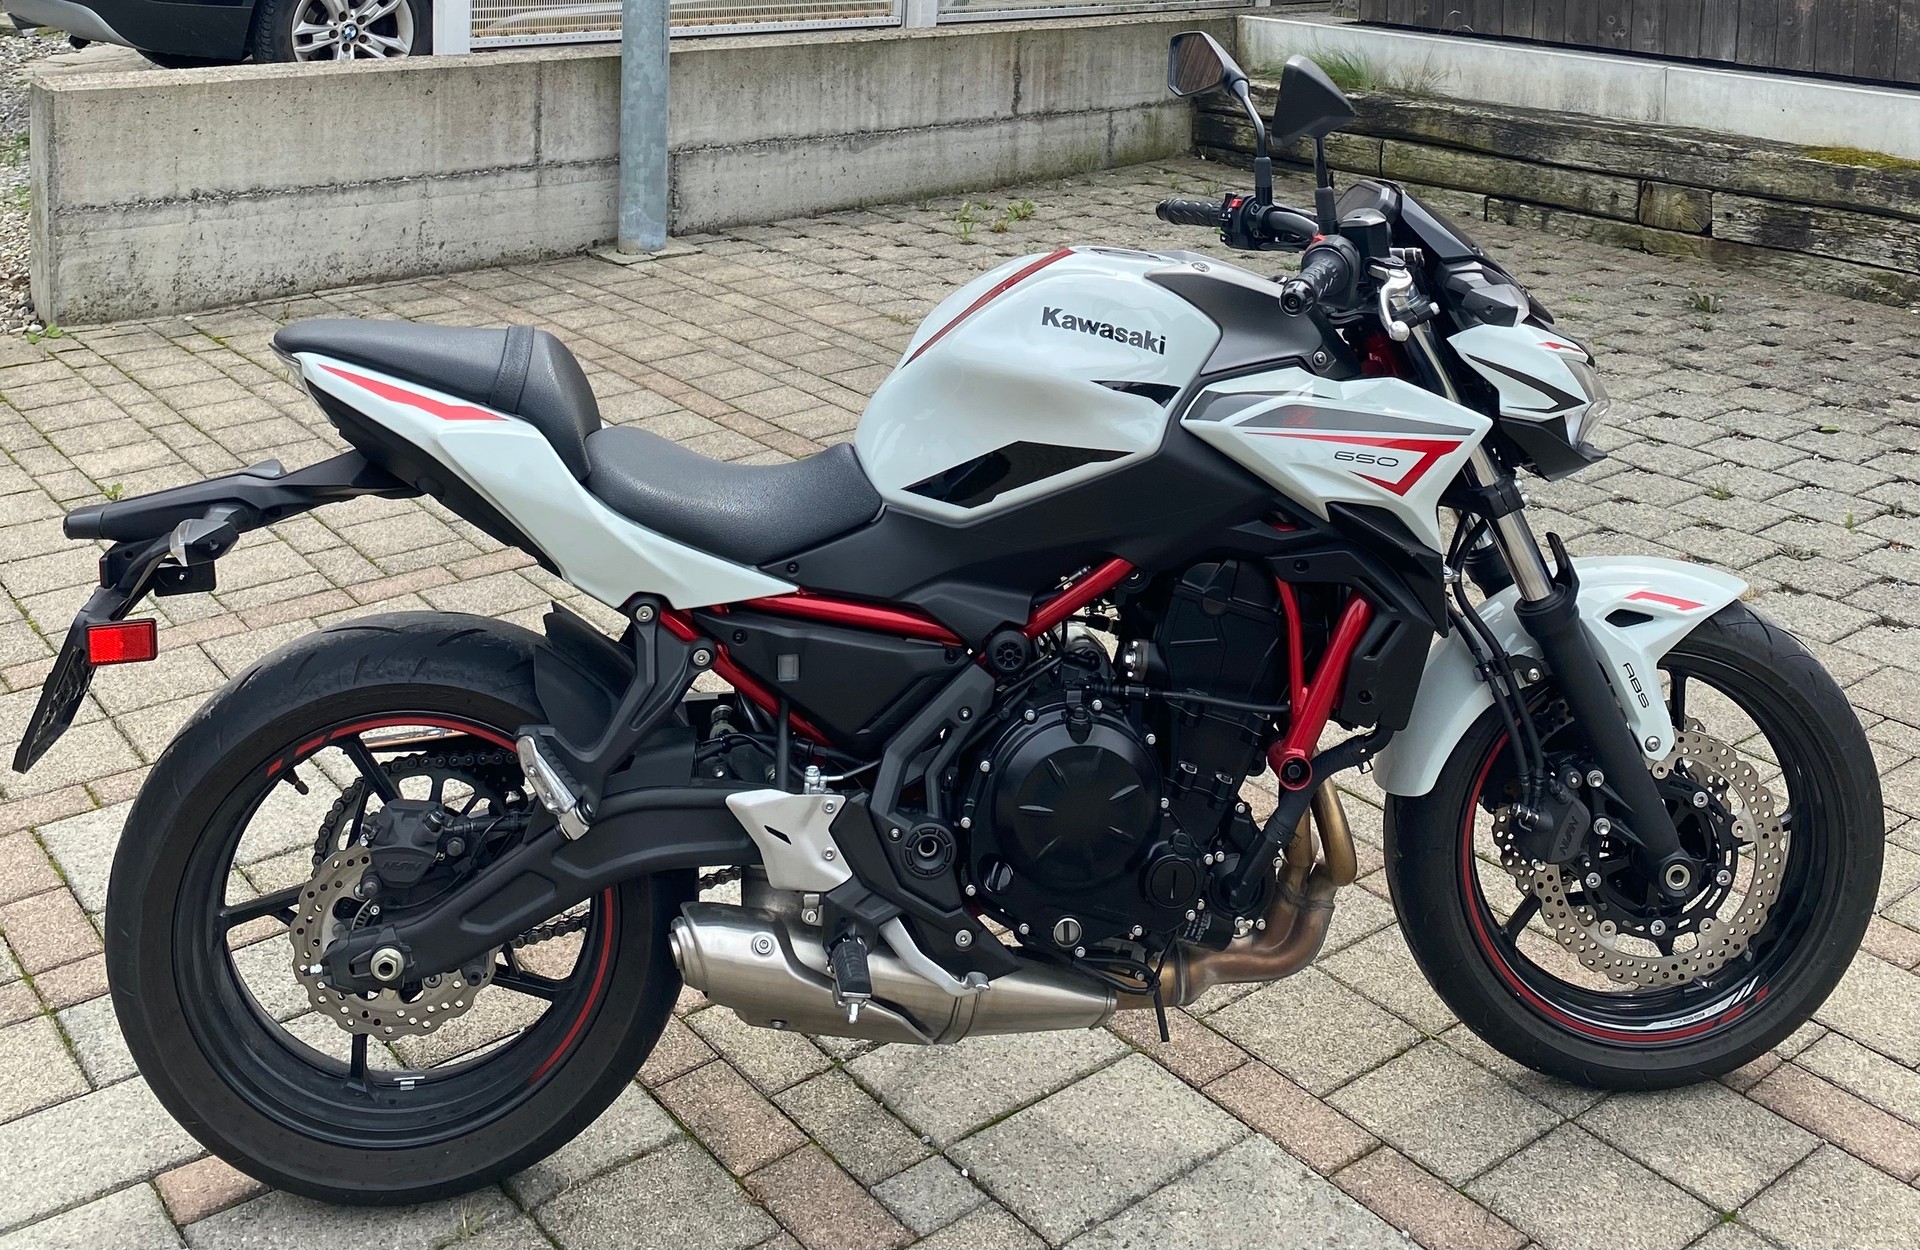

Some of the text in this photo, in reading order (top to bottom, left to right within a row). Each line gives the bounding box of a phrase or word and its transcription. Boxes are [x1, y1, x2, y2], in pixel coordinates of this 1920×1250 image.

[1041, 306, 1166, 355] Kawasaki
[1334, 451, 1399, 467] 650
[1623, 662, 1650, 708] ABS
